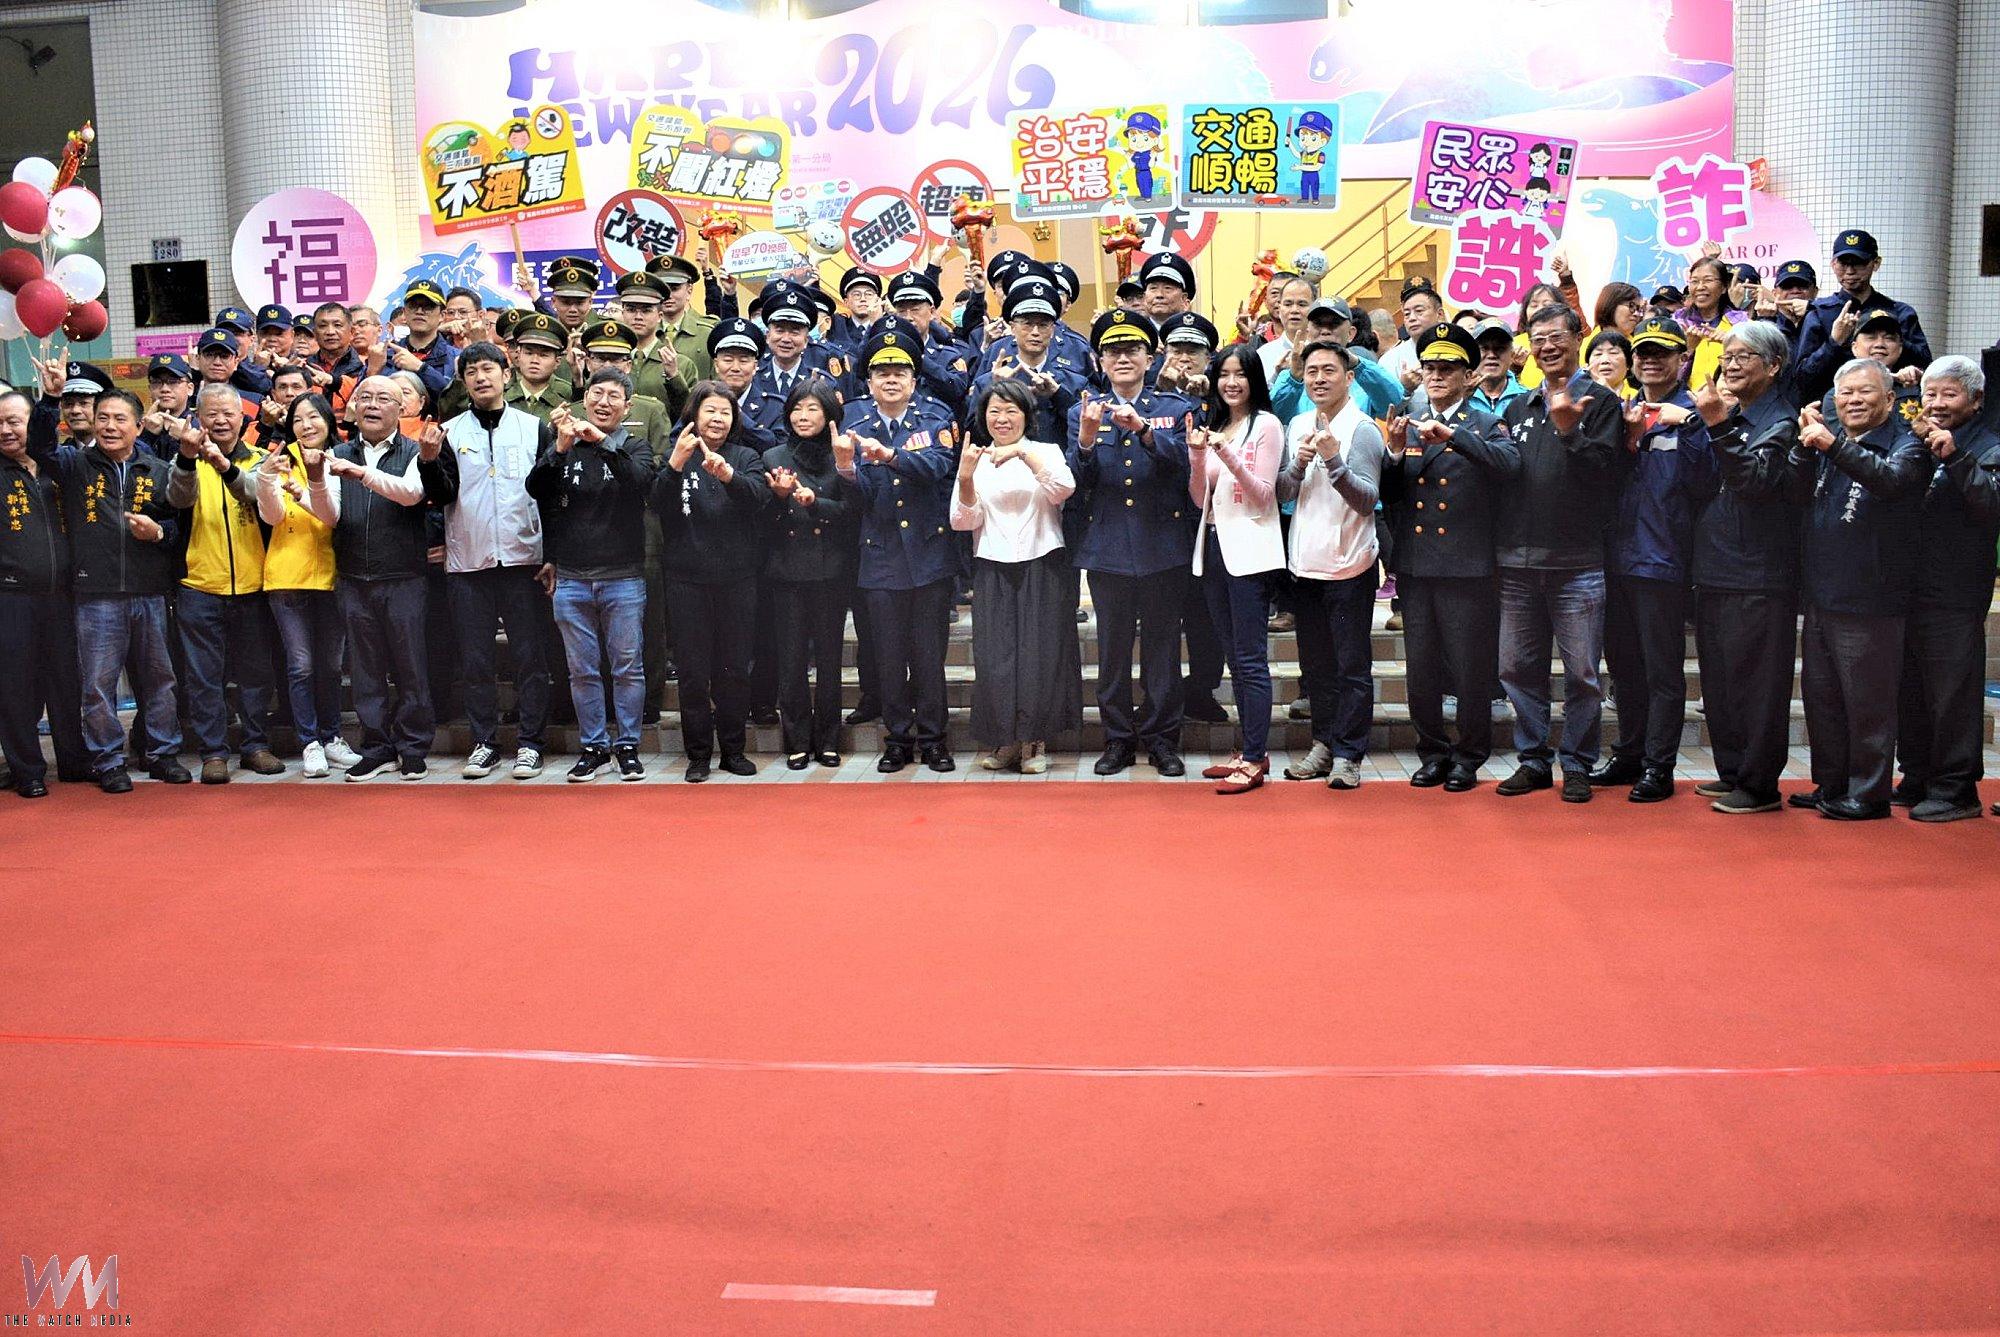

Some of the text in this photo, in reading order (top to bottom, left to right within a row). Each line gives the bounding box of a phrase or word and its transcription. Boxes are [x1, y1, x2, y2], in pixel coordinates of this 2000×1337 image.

[508, 40, 815, 101] HAP
[816, 19, 1056, 135] 2026
[512, 97, 646, 147] EW
[1017, 112, 1108, 159] 治安
[1191, 107, 1277, 152] 交通
[639, 132, 783, 201] 不闖紅燈
[1189, 150, 1278, 195] 順暢
[1431, 126, 1517, 175] 民眾
[436, 151, 569, 219] 不酒駕
[1022, 156, 1112, 202] 平穩
[1426, 170, 1511, 213] 安心
[1658, 160, 1750, 246] 詐
[160, 248, 178, 260] 280
[603, 206, 679, 256] 改裝
[851, 199, 917, 263] 無照
[1754, 243, 1778, 258] OF
[261, 217, 349, 304] 福
[1448, 217, 1545, 307] 識
